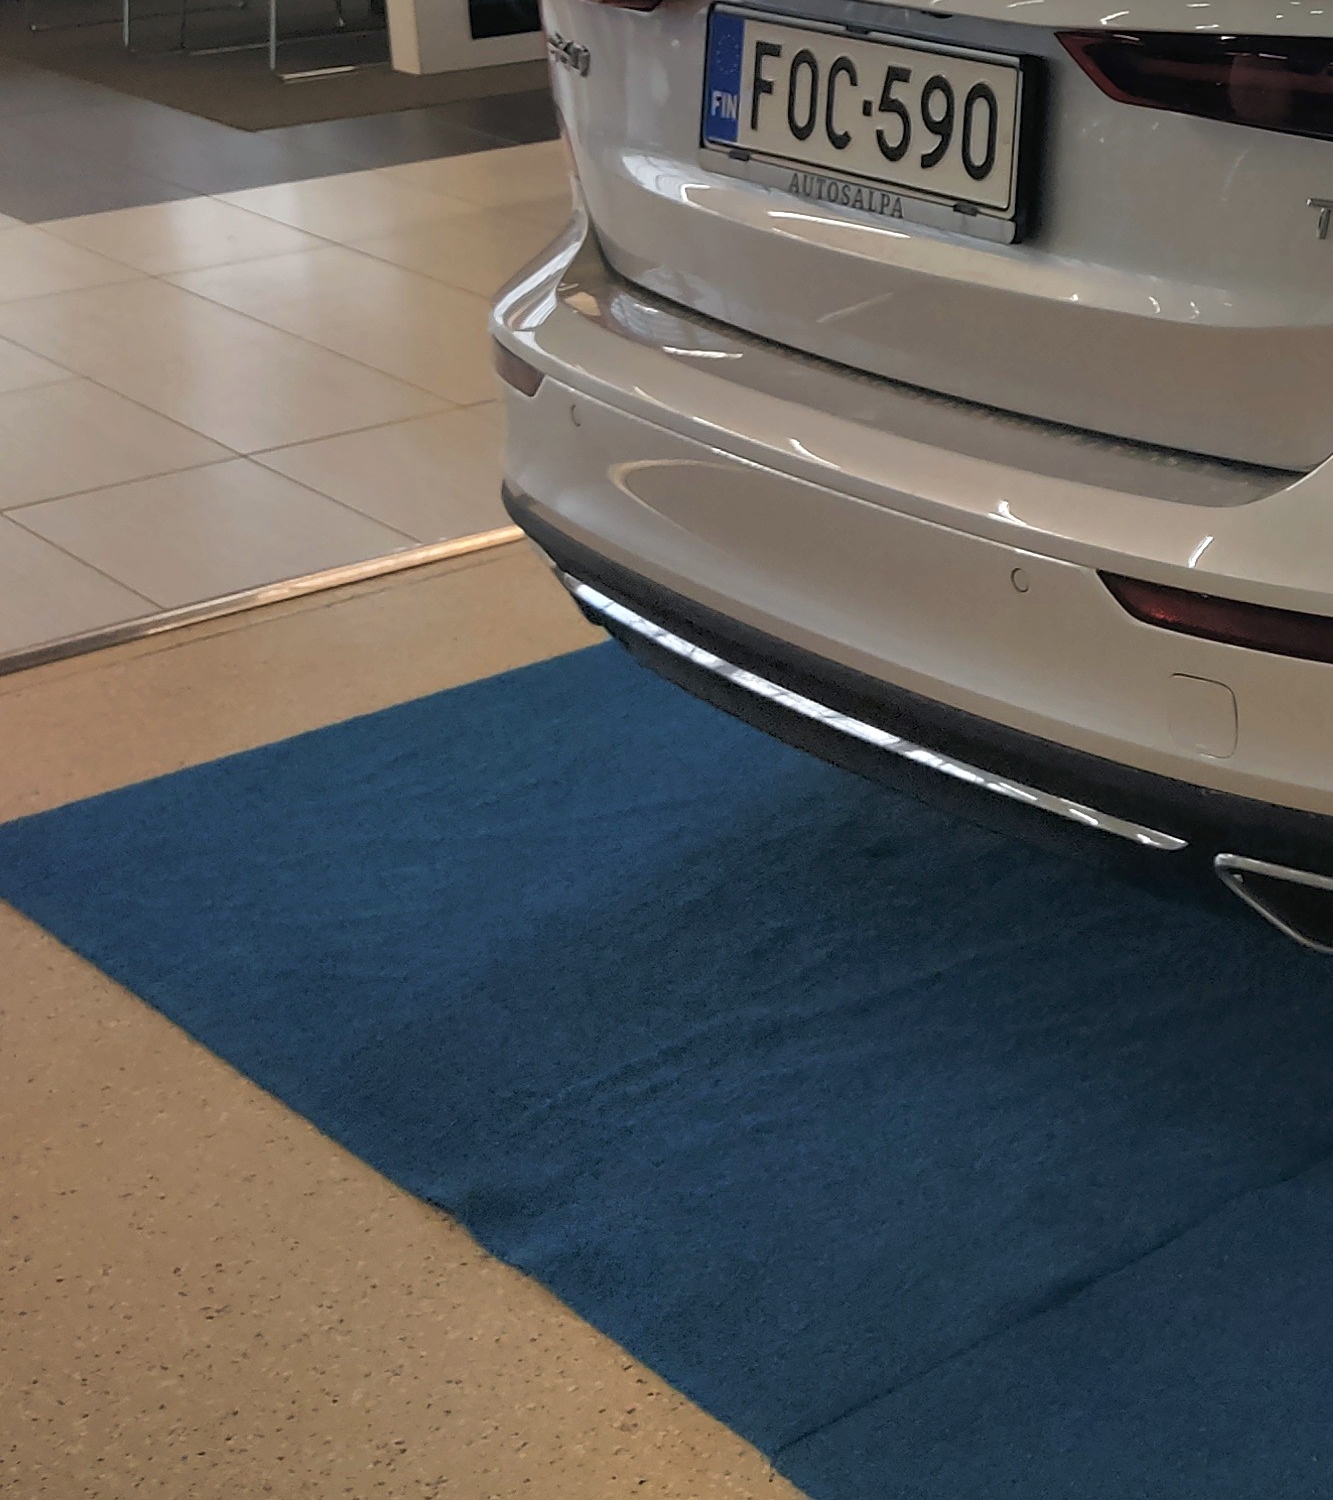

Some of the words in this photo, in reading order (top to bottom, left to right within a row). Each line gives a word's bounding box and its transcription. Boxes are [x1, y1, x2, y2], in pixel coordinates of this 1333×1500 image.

[710, 89, 738, 121] FIN
[750, 40, 999, 181] FOC-590
[787, 171, 905, 220] AUTOSALPA
